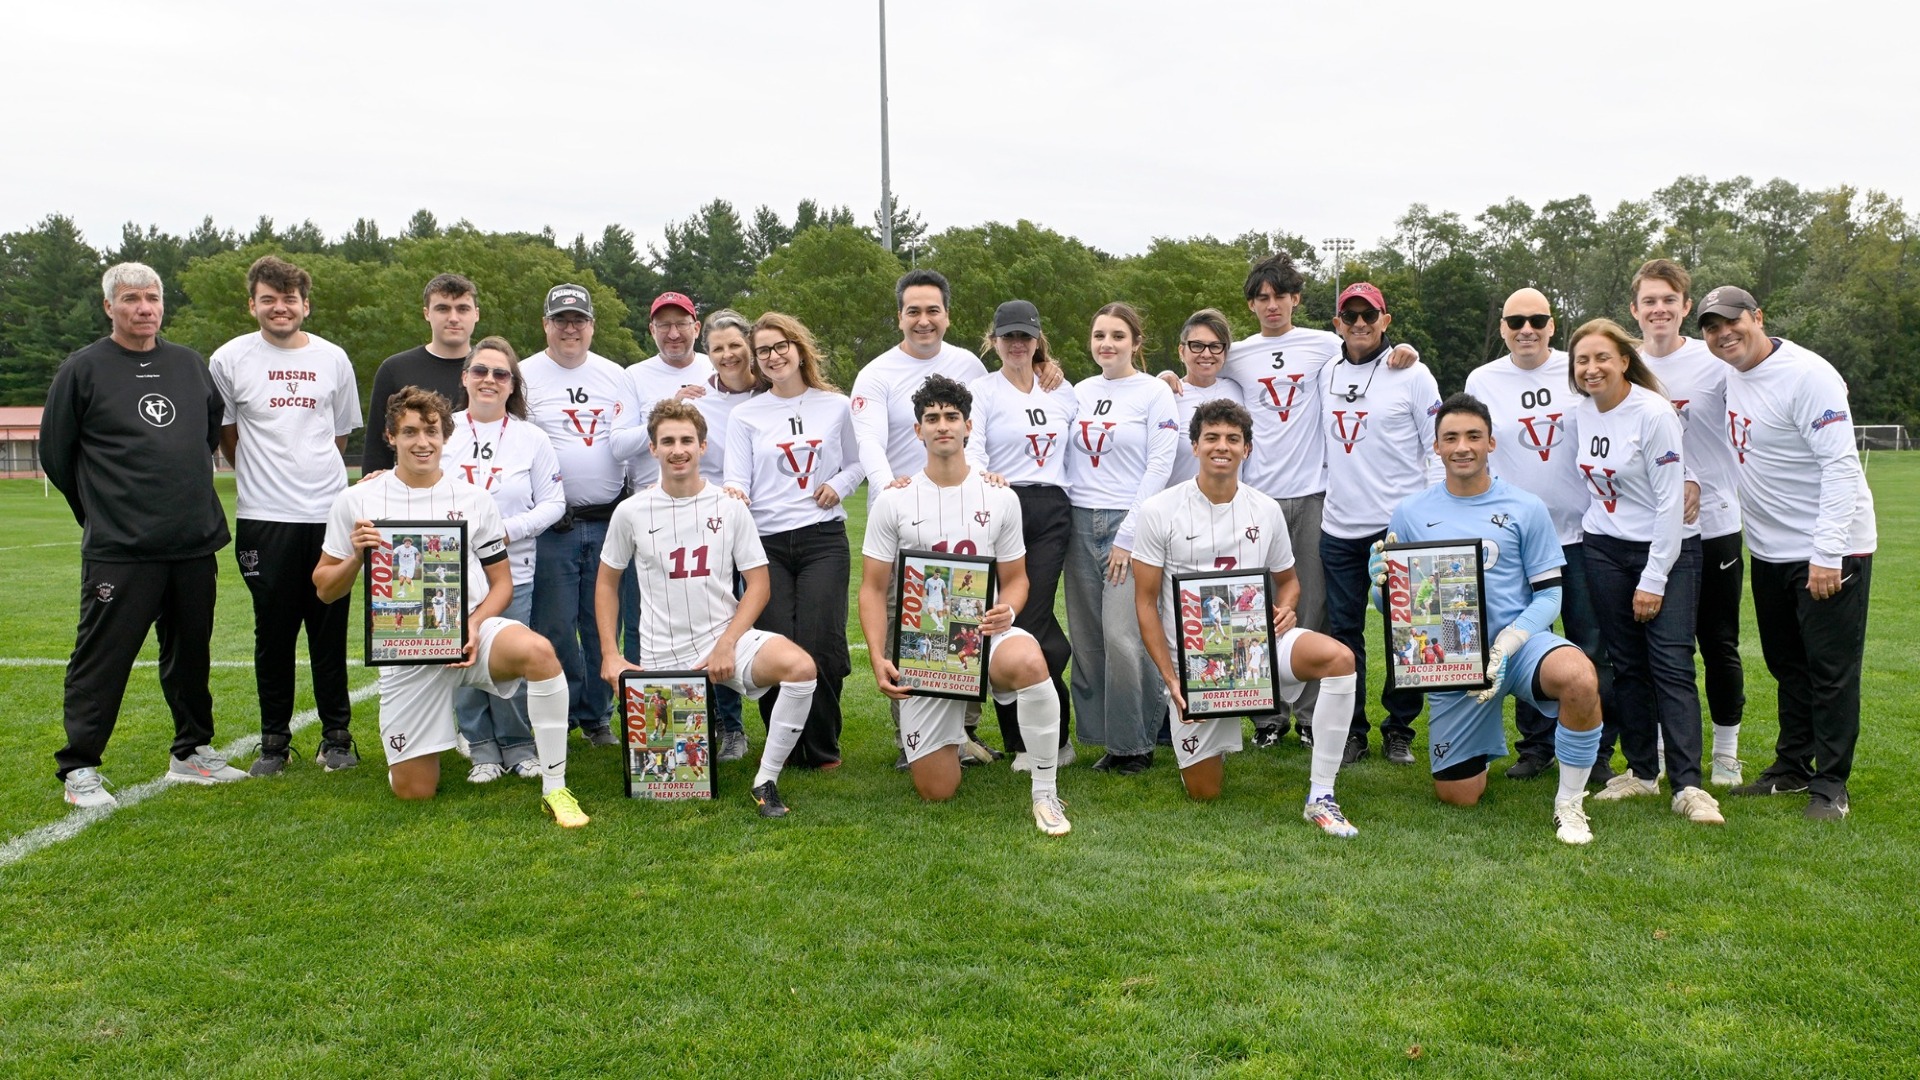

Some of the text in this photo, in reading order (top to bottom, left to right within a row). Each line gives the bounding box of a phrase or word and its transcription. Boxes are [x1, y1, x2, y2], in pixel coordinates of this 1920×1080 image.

[1271, 352, 1285, 370] 3
[268, 370, 316, 382] VASSAR
[566, 387, 589, 404] 16
[1344, 384, 1359, 403] 3
[1521, 388, 1552, 410] 00
[269, 396, 316, 410] SOCCER
[1092, 399, 1112, 416] 10
[1026, 408, 1047, 426] 10
[788, 417, 804, 436] 11
[473, 441, 493, 460] 16
[1591, 435, 1610, 459] 00
[668, 545, 711, 580] 11
[902, 565, 924, 629] 2027
[1388, 559, 1411, 624] 2027
[1180, 589, 1204, 652] 2027
[382, 639, 422, 647] JACKSON
[372, 648, 397, 658] #16
[904, 669, 976, 683] MAURICIO MEJIA
[1406, 664, 1473, 673] JACOB RAPHAN
[922, 681, 948, 689] MEN'S
[949, 683, 980, 692] SOCCER
[1395, 674, 1420, 685] #00
[1451, 673, 1483, 681] SOCCER
[1202, 691, 1230, 699] KORAY
[1191, 701, 1209, 711] #3
[1213, 700, 1240, 708] MEN'S
[626, 686, 647, 745] 2027
[663, 782, 695, 790] TORREY
